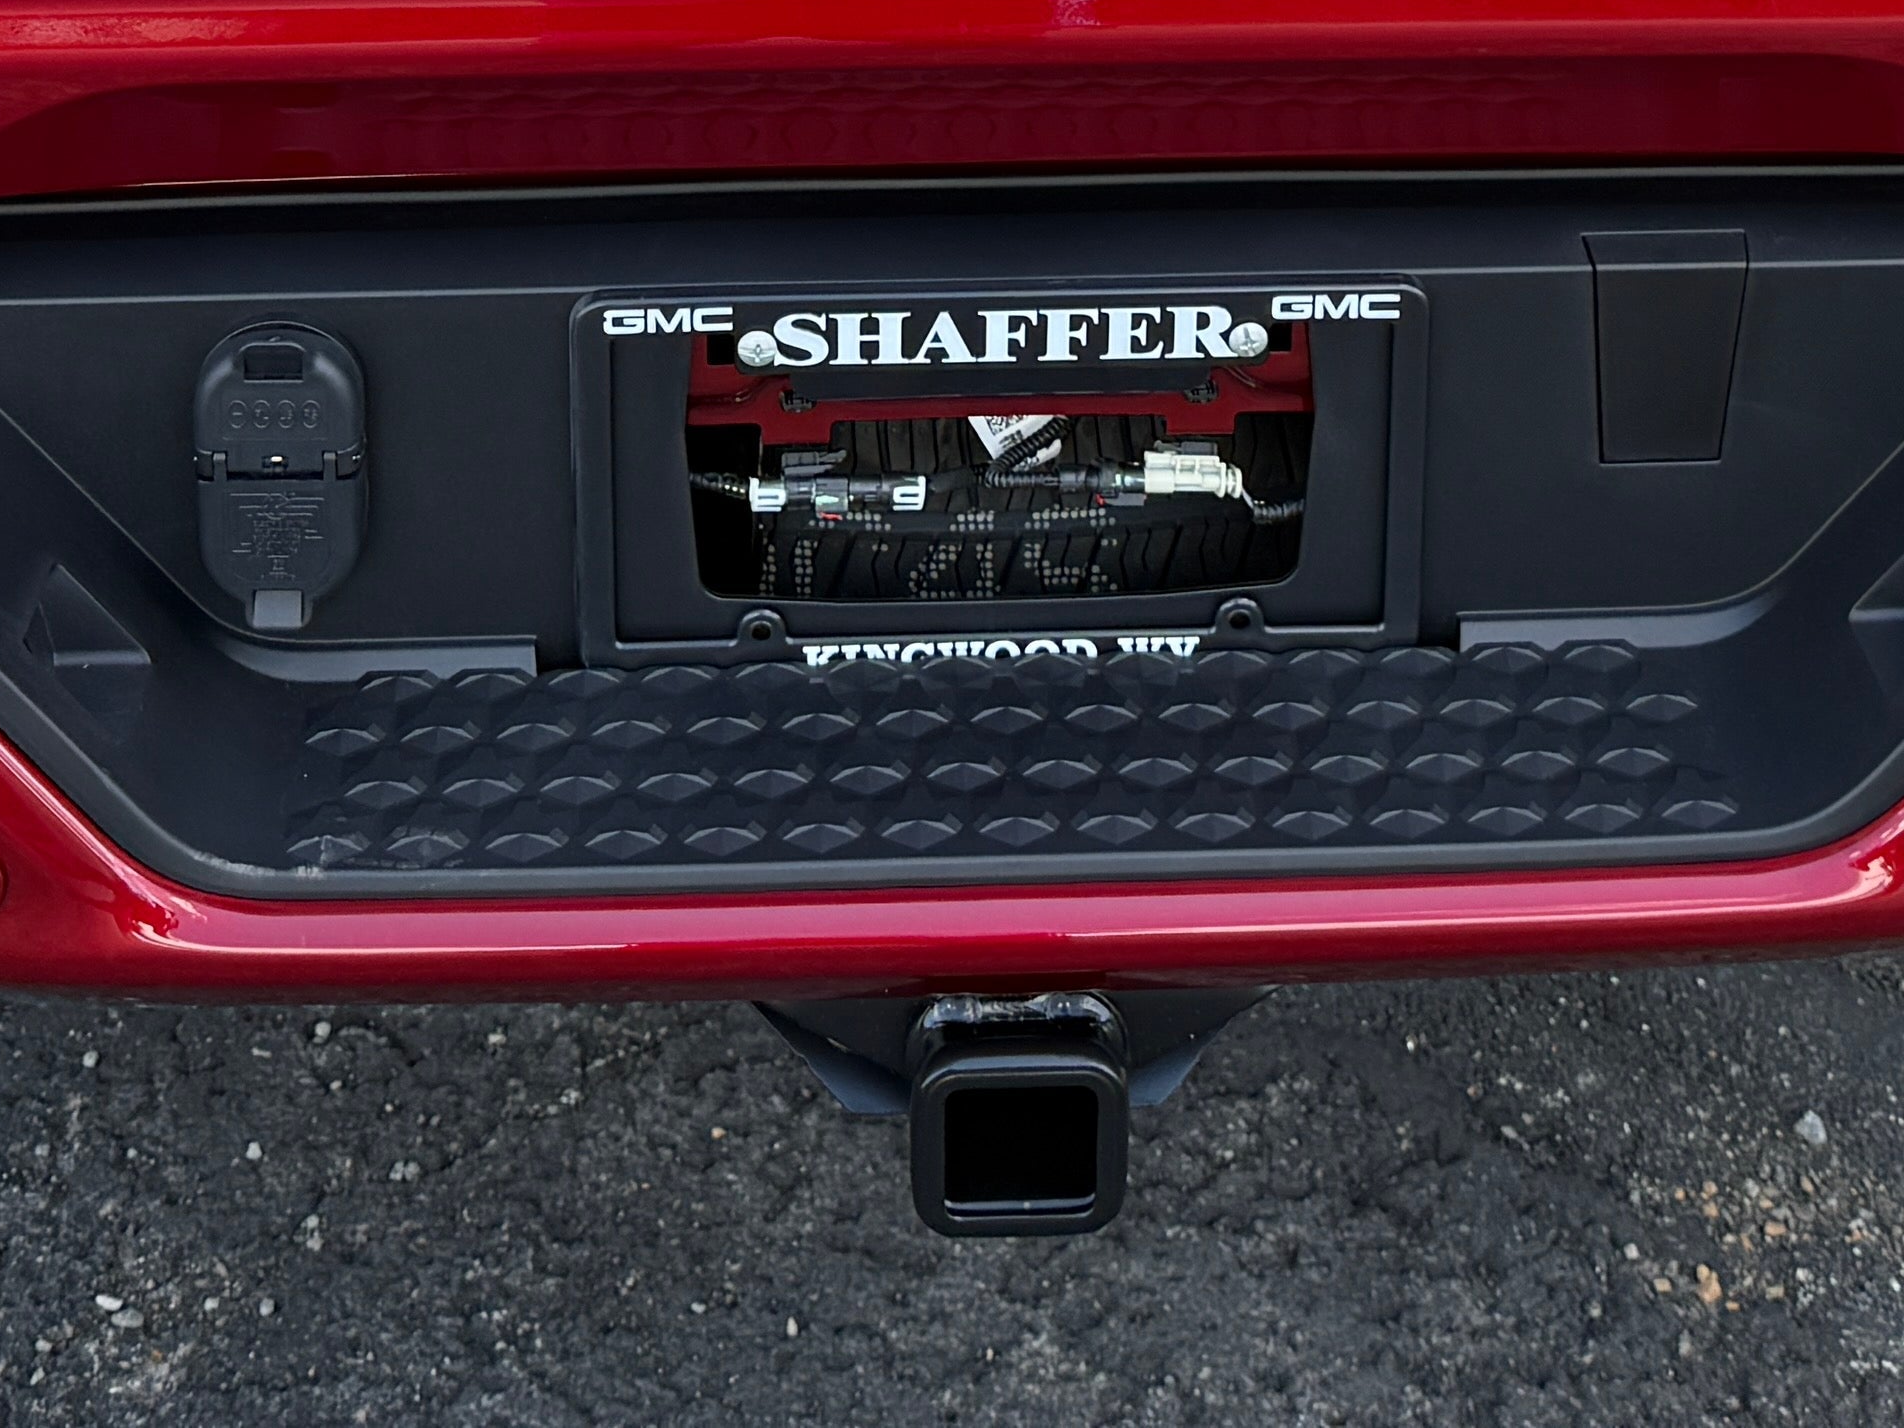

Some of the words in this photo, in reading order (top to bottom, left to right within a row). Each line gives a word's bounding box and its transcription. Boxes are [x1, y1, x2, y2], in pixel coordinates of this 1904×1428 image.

[603, 307, 733, 335] GMC
[772, 305, 1239, 367] SHAFFER
[1271, 294, 1400, 320] GMC
